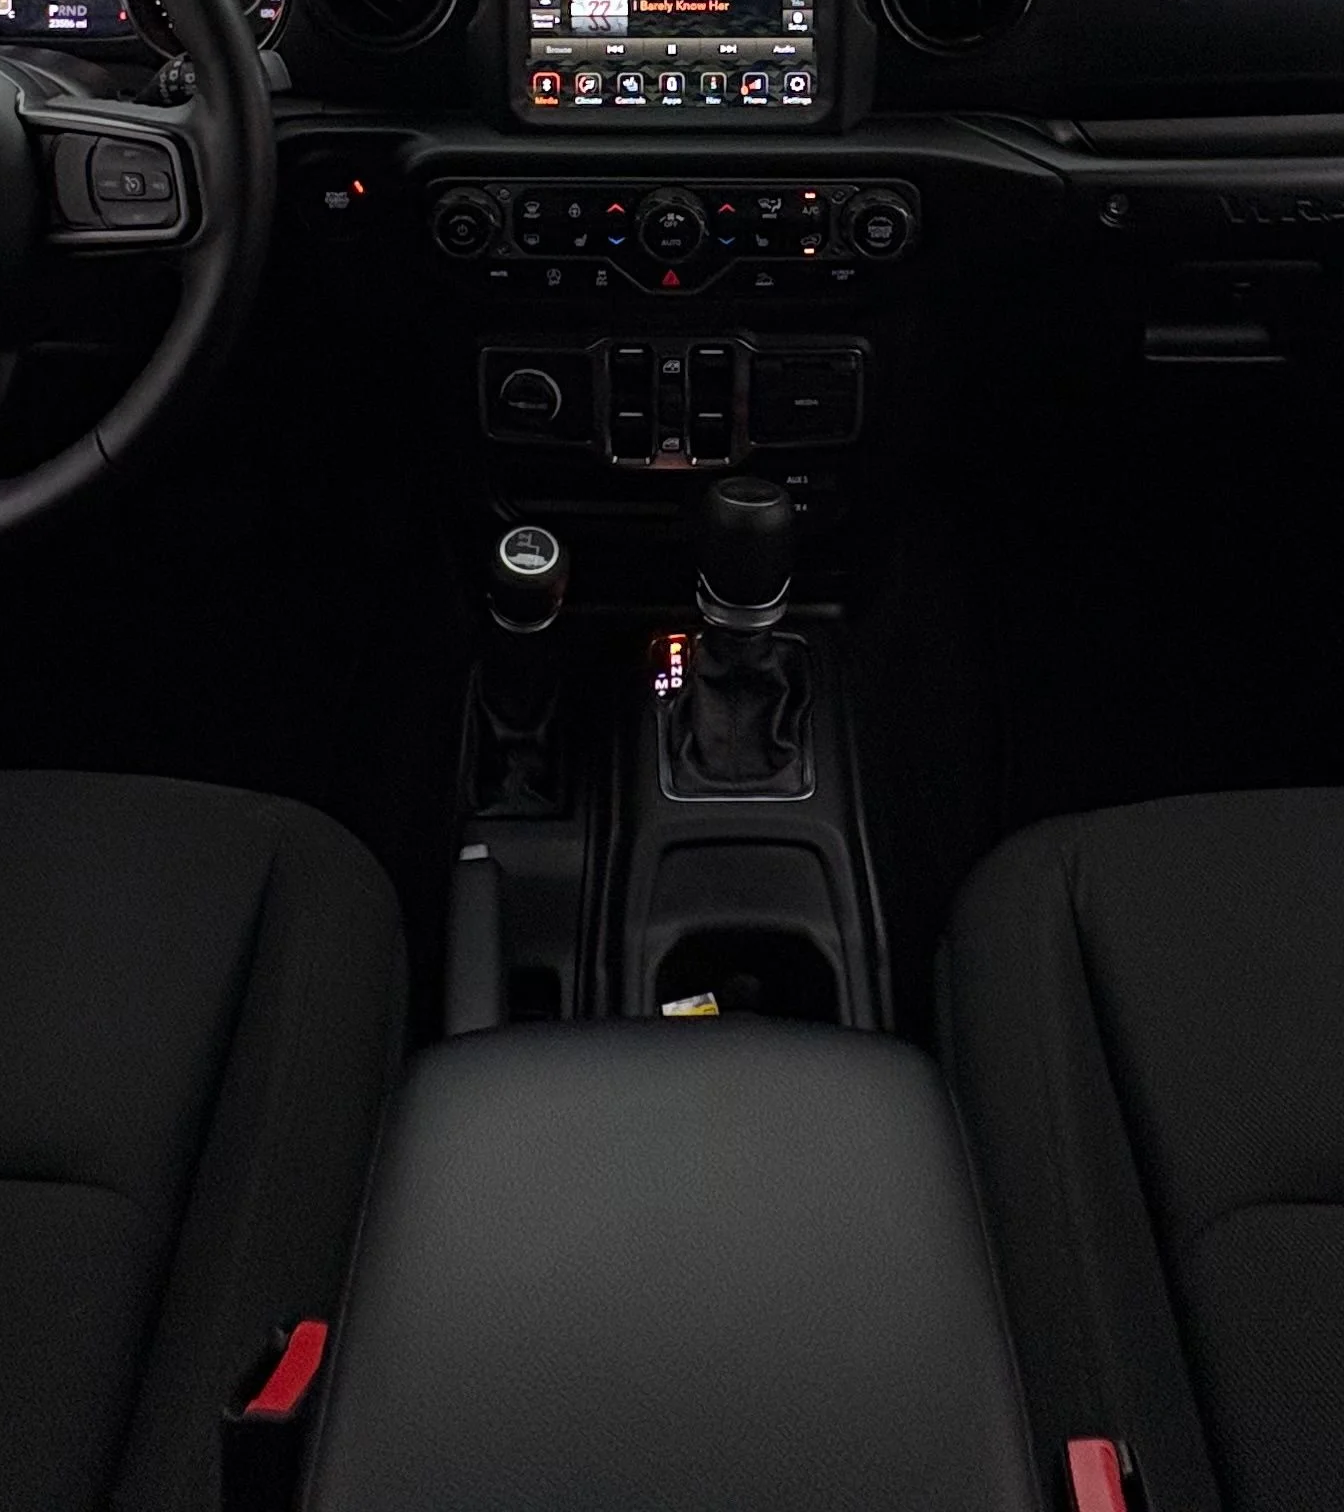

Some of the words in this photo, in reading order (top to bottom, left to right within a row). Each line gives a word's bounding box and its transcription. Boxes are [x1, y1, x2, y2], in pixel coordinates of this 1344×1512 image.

[48, 4, 88, 17] PRND
[640, 0, 674, 14] Barely
[676, 0, 706, 11] Know
[709, 0, 730, 11] Her
[662, 96, 682, 106] Apps
[743, 96, 768, 106] Phone
[801, 206, 820, 216] A/C
[670, 642, 682, 654] P
[670, 665, 683, 676] N
[654, 678, 669, 690] M
[670, 677, 683, 688] D
